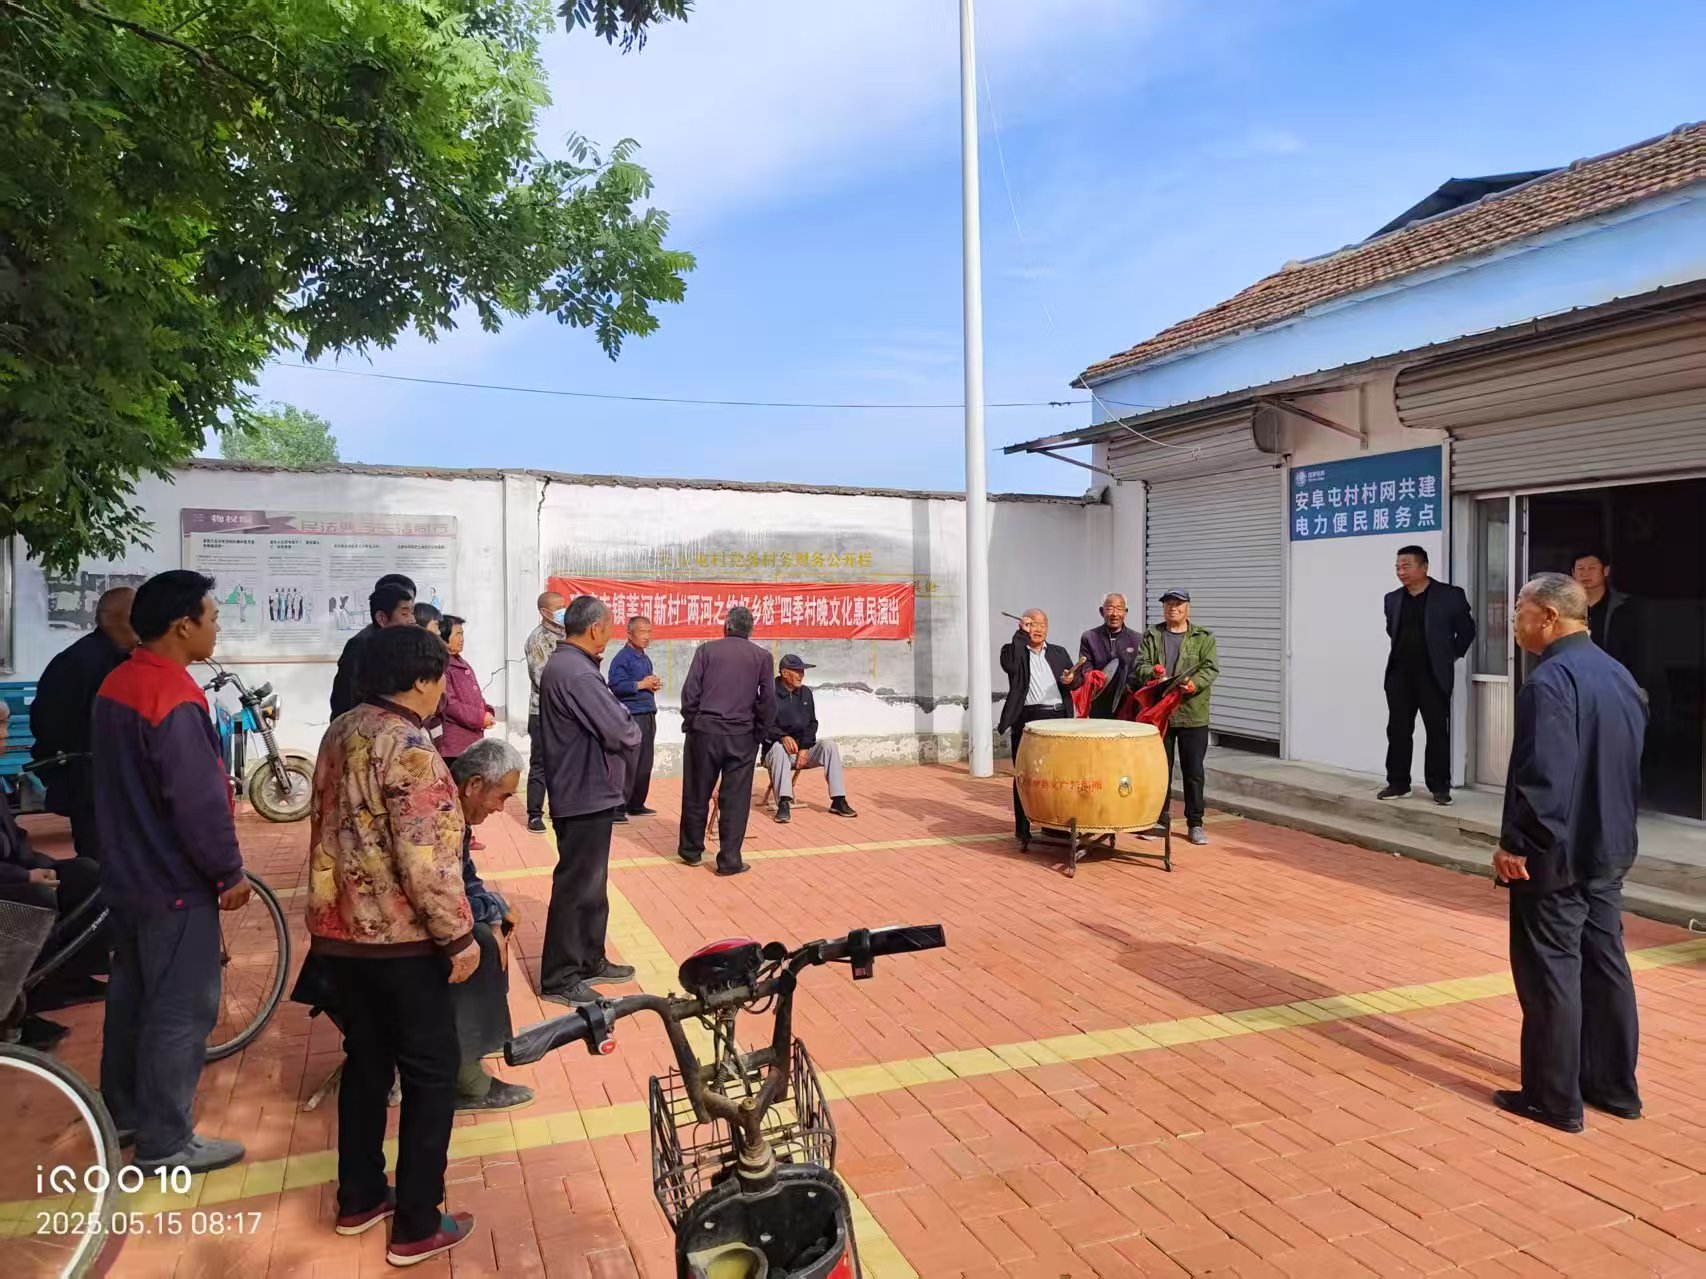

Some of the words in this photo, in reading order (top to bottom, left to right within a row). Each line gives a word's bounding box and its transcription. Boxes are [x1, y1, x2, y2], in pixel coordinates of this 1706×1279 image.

[1295, 475, 1437, 512] 安阜屯村村网共建
[1295, 503, 1436, 536] 电力便民服务点
